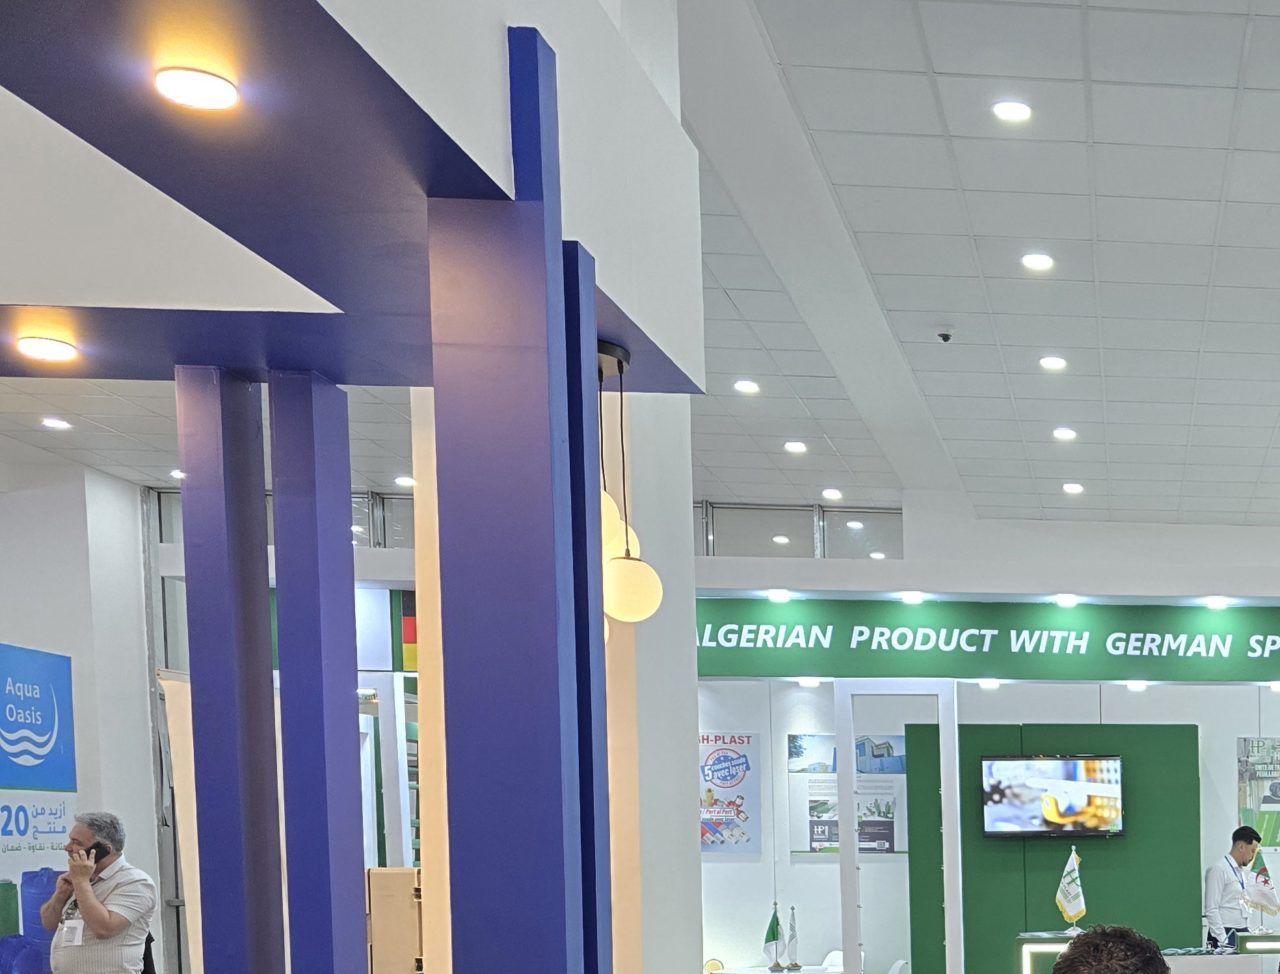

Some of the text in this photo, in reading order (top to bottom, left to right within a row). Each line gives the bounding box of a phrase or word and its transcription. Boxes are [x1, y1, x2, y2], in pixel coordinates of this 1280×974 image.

[850, 625, 998, 652] PRODUCT
[1009, 629, 1089, 655] WITH
[1105, 631, 1233, 658] GERMAN
[5, 677, 41, 701] Aqua
[5, 703, 42, 726] Oasis
[0, 804, 30, 837] 20
[32, 804, 46, 819] من
[32, 821, 67, 841] منتج
